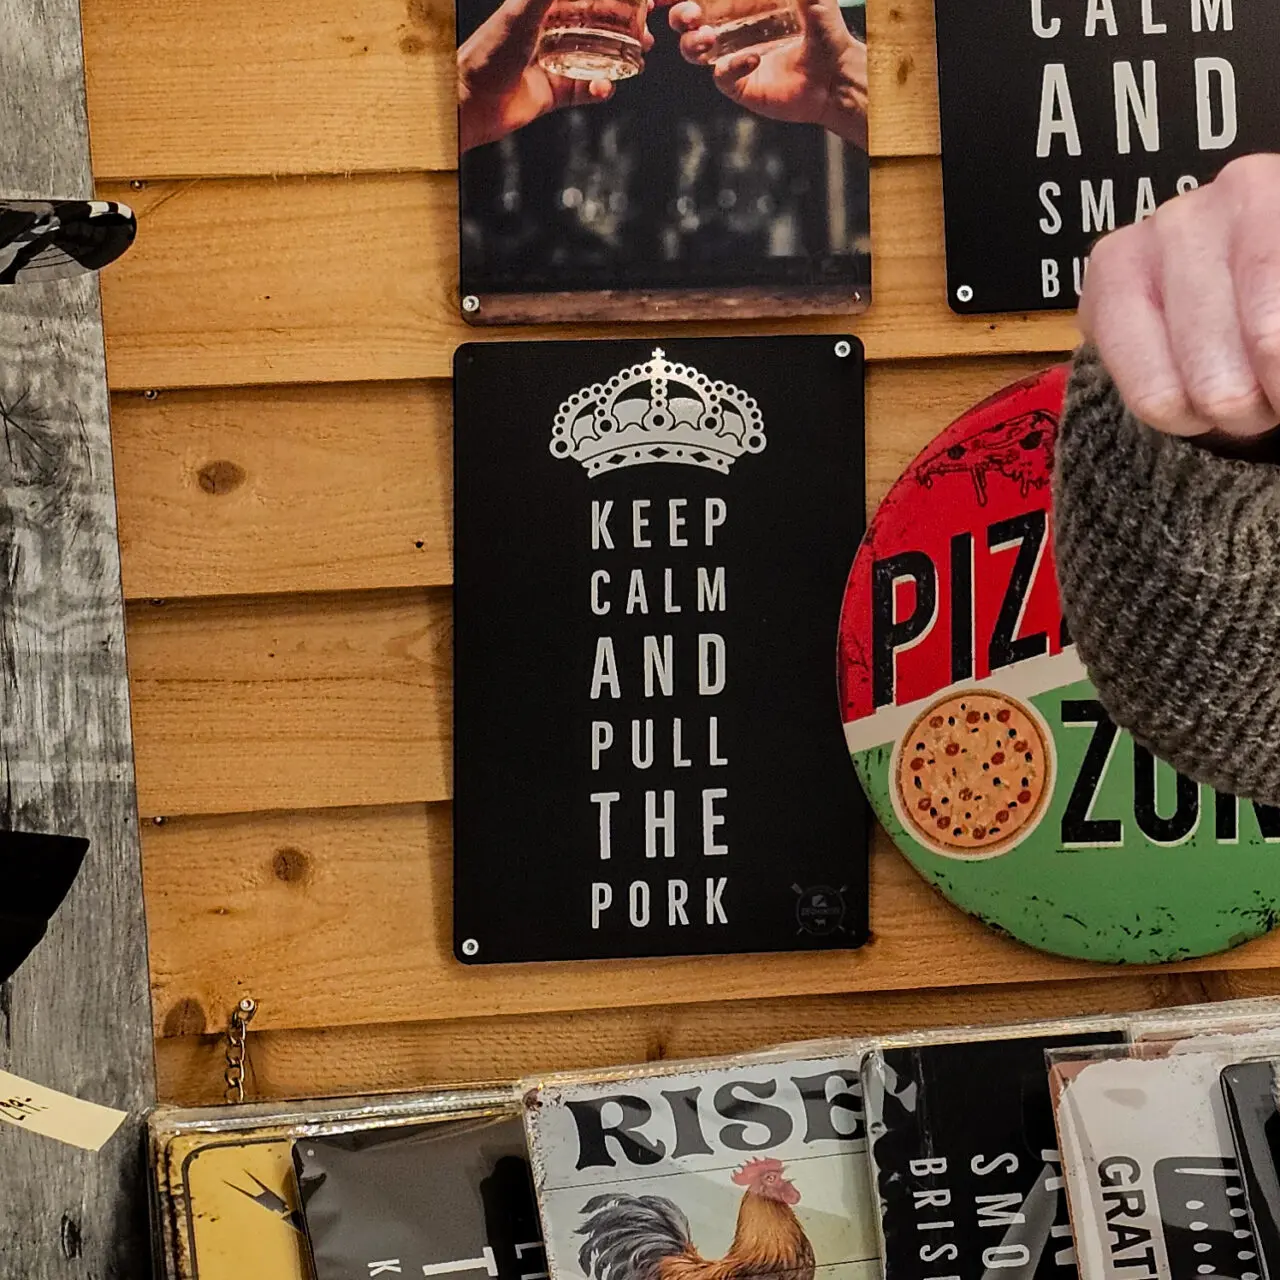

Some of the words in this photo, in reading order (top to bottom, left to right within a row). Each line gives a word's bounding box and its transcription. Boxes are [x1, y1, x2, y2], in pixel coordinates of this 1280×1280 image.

[1035, 56, 1238, 159] AND
[591, 497, 728, 550] KEEP
[590, 566, 727, 616] CALM
[870, 508, 1073, 718] PIZ
[589, 633, 727, 700] AND
[591, 716, 729, 770] PULL
[590, 787, 729, 861] THE
[591, 876, 729, 930] PORK
[909, 1157, 961, 1280] BRIS
